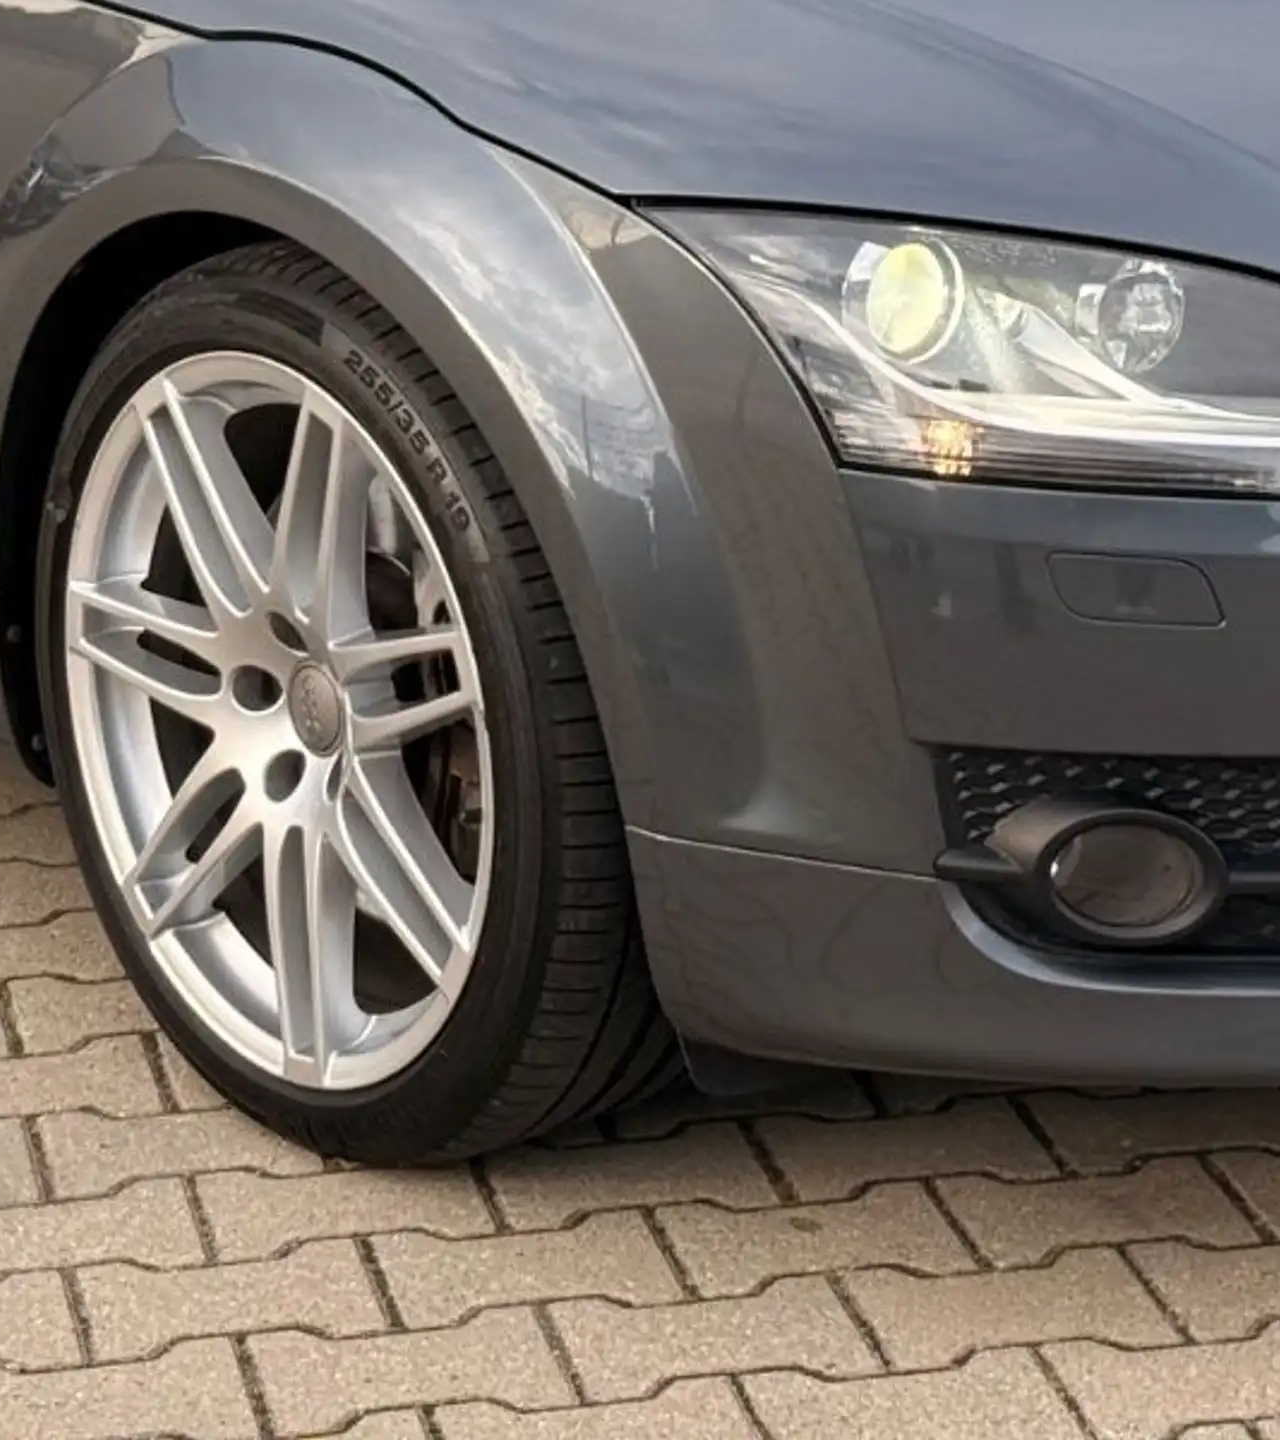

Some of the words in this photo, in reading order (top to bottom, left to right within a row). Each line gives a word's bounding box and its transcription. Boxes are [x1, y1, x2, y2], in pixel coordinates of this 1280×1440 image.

[344, 349, 431, 456] 255/35
[426, 458, 449, 486] R
[444, 491, 471, 532] 19
